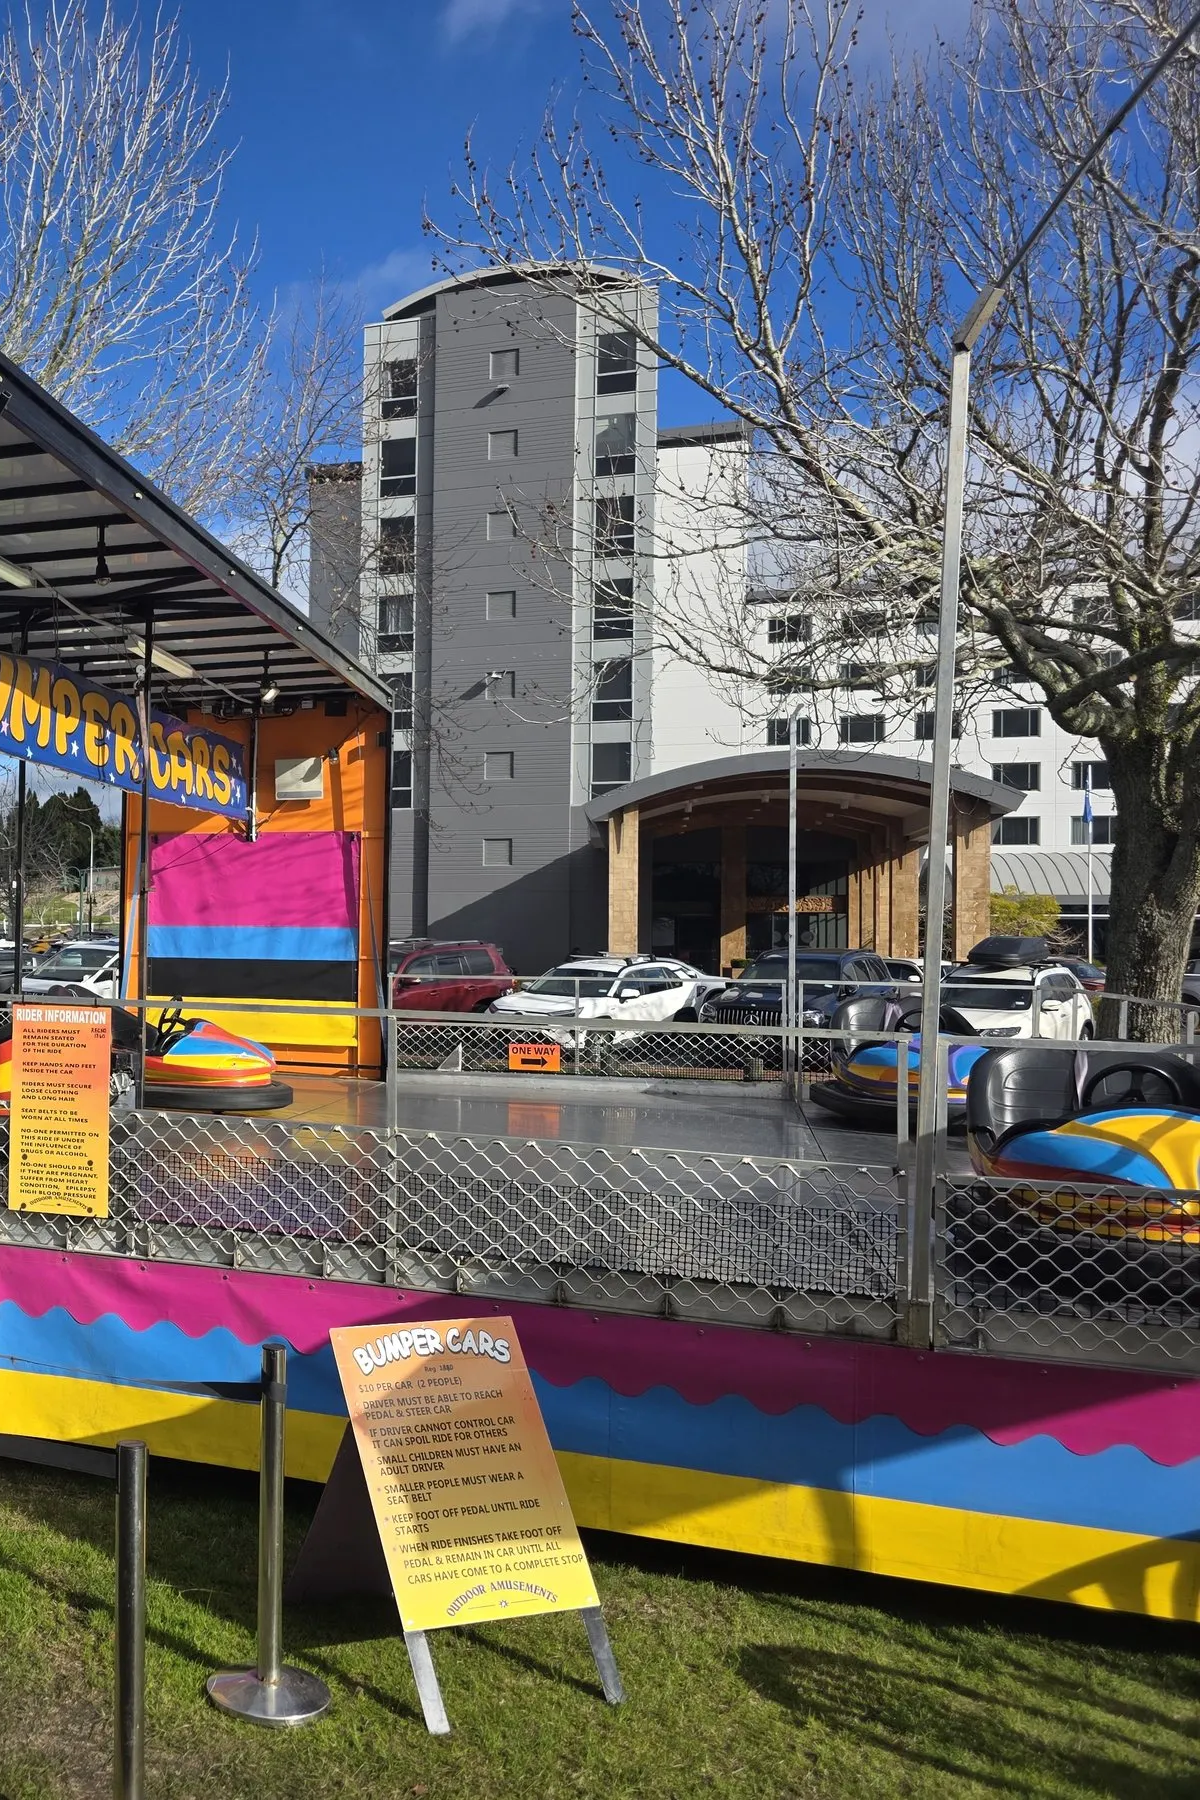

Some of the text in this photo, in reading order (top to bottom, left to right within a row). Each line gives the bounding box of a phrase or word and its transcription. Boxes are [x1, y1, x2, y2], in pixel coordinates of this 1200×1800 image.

[150, 720, 233, 806] CARS
[16, 1009, 106, 1024] RIDER INFORMATION
[534, 1047, 555, 1055] WAY
[352, 1327, 512, 1376] BUMPER CARS
[359, 1376, 462, 1393] $10 PER CAR (2 PEOPLE)
[363, 1389, 503, 1410] DRIVER MUST BE ABLE TO REACH
[365, 1405, 452, 1420] PEDAL & STEER CAR
[369, 1416, 515, 1438] IF DRIVER CANNOT CONTROL CAR
[372, 1428, 508, 1449] IT CAN SPOIL RIDE FOR OTHERS
[377, 1442, 522, 1465] SMALL CHILDREN MUST HAVE AN
[380, 1461, 445, 1476] ADULT DRIVER
[384, 1471, 524, 1494] SMALLER PEOPLE MUST WEAR A
[387, 1492, 432, 1505] SEAT BELT
[392, 1499, 540, 1524] KEEP FOOT OFF PEDAL UNTIL RIDE
[395, 1524, 430, 1536] STARTS
[399, 1526, 562, 1554] WHEN RIDE FINISHES TAKE FOOT OFF
[404, 1541, 561, 1569] PEDAL & REMAIN IN CAR UNTIL ALL
[408, 1554, 583, 1585] CARS HAVE COME TO A COMPLETE STOP
[446, 1580, 559, 1617] OUTDOOR AMUSEMENTS
